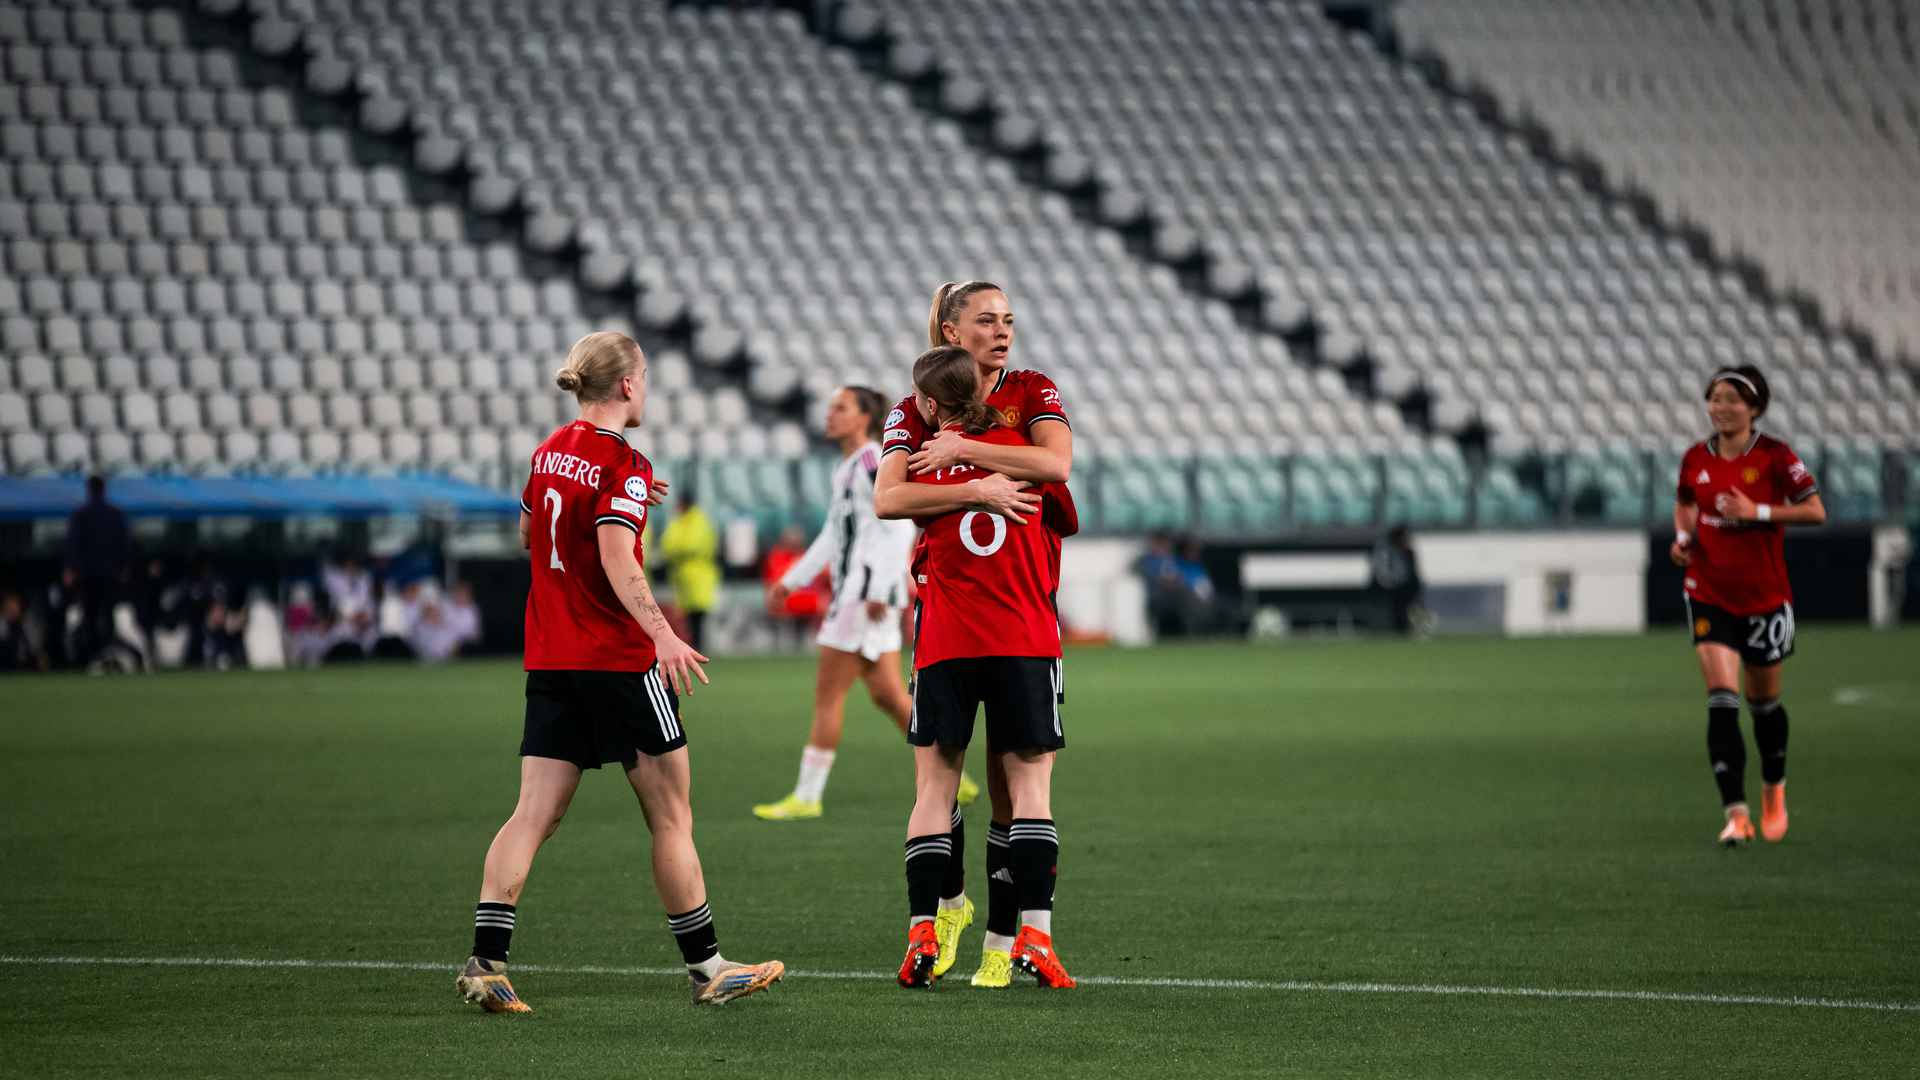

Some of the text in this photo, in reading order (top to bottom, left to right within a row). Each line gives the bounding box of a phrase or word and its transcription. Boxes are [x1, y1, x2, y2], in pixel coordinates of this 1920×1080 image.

[534, 451, 601, 490] ANDBERG
[544, 487, 566, 573] 2
[1748, 613, 1786, 649] 20
